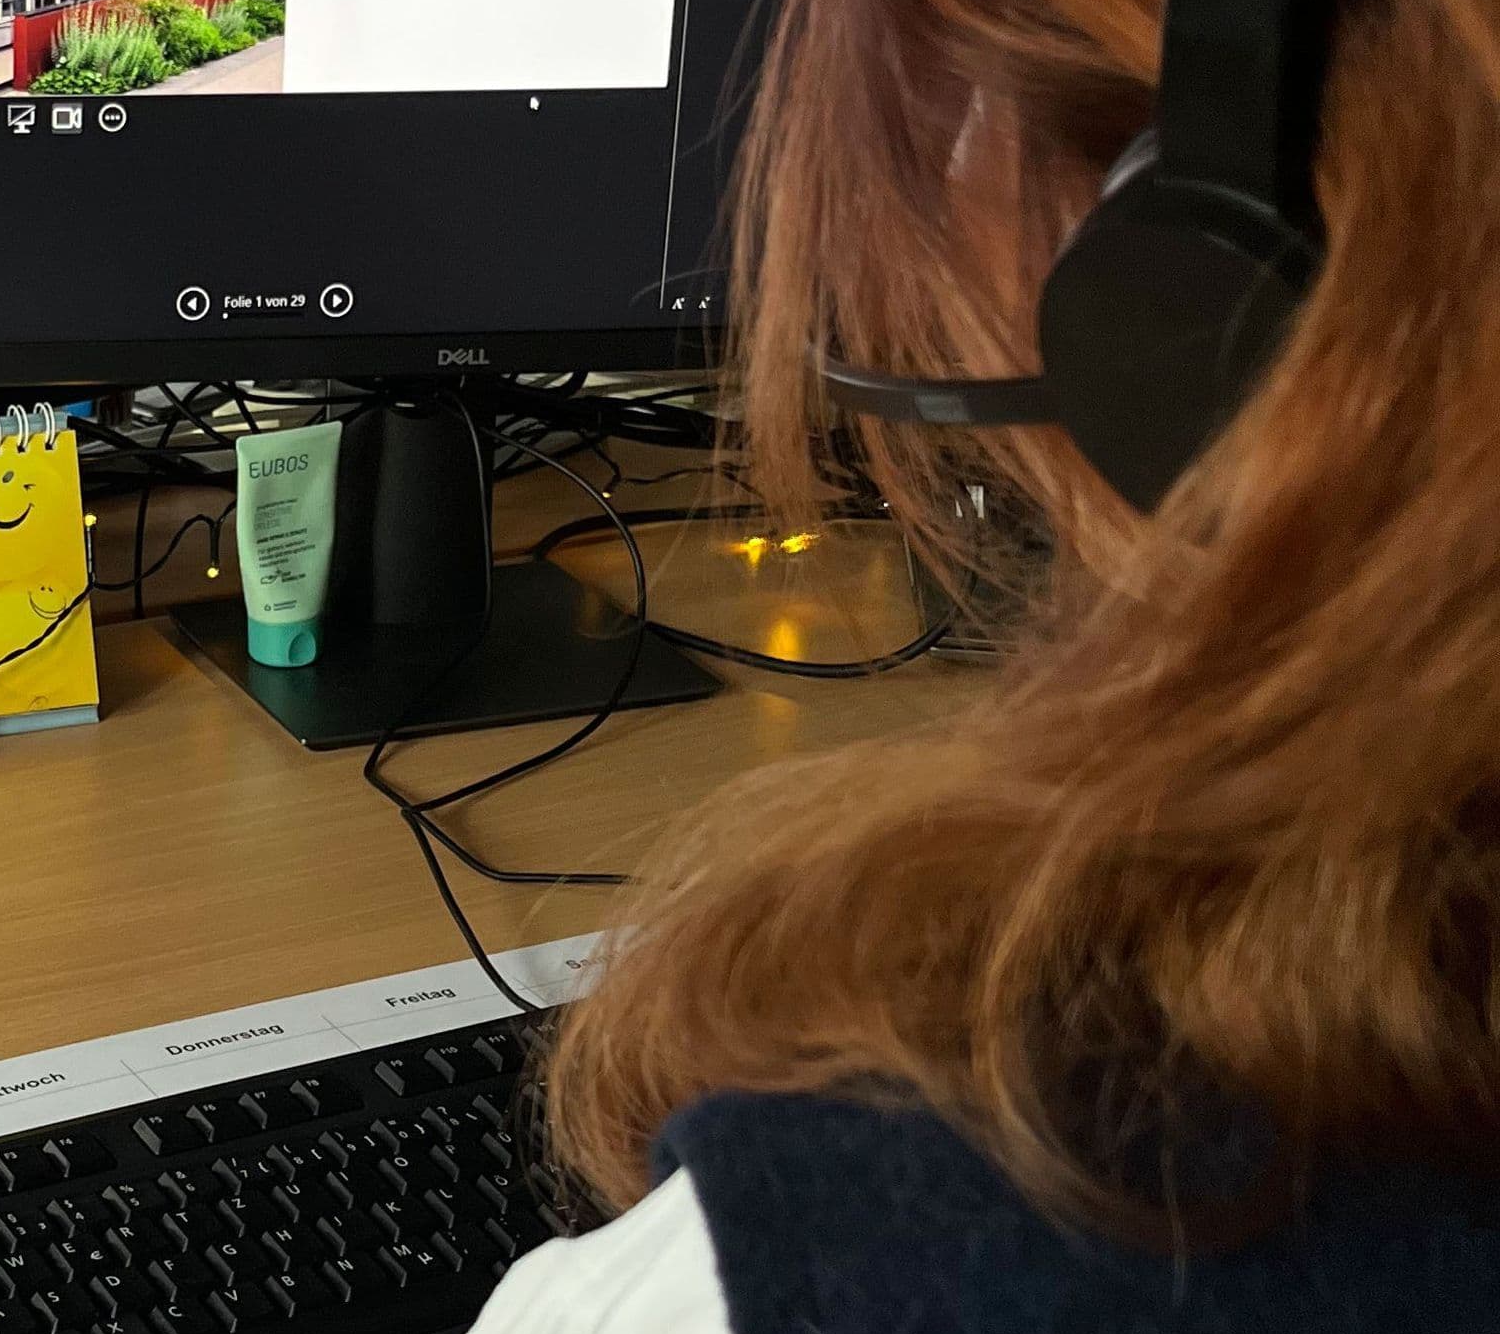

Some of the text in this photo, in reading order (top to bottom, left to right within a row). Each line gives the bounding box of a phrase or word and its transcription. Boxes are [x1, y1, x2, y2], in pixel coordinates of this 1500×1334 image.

[224, 294, 306, 309] Folie 1 von 29
[437, 348, 490, 366] DELL
[249, 454, 309, 479] EUBOS
[385, 986, 457, 1010] Freitag
[165, 1021, 285, 1057] Donnerstag
[276, 1229, 292, 1242] H
[62, 1242, 76, 1253] E
[222, 1244, 237, 1255] G
[392, 1244, 412, 1256] M
[4, 1255, 25, 1268] W
[106, 1275, 121, 1287] D
[281, 1275, 296, 1287] B
[48, 1291, 60, 1303] S
[168, 1306, 182, 1317] C
[107, 1321, 124, 1334] X
